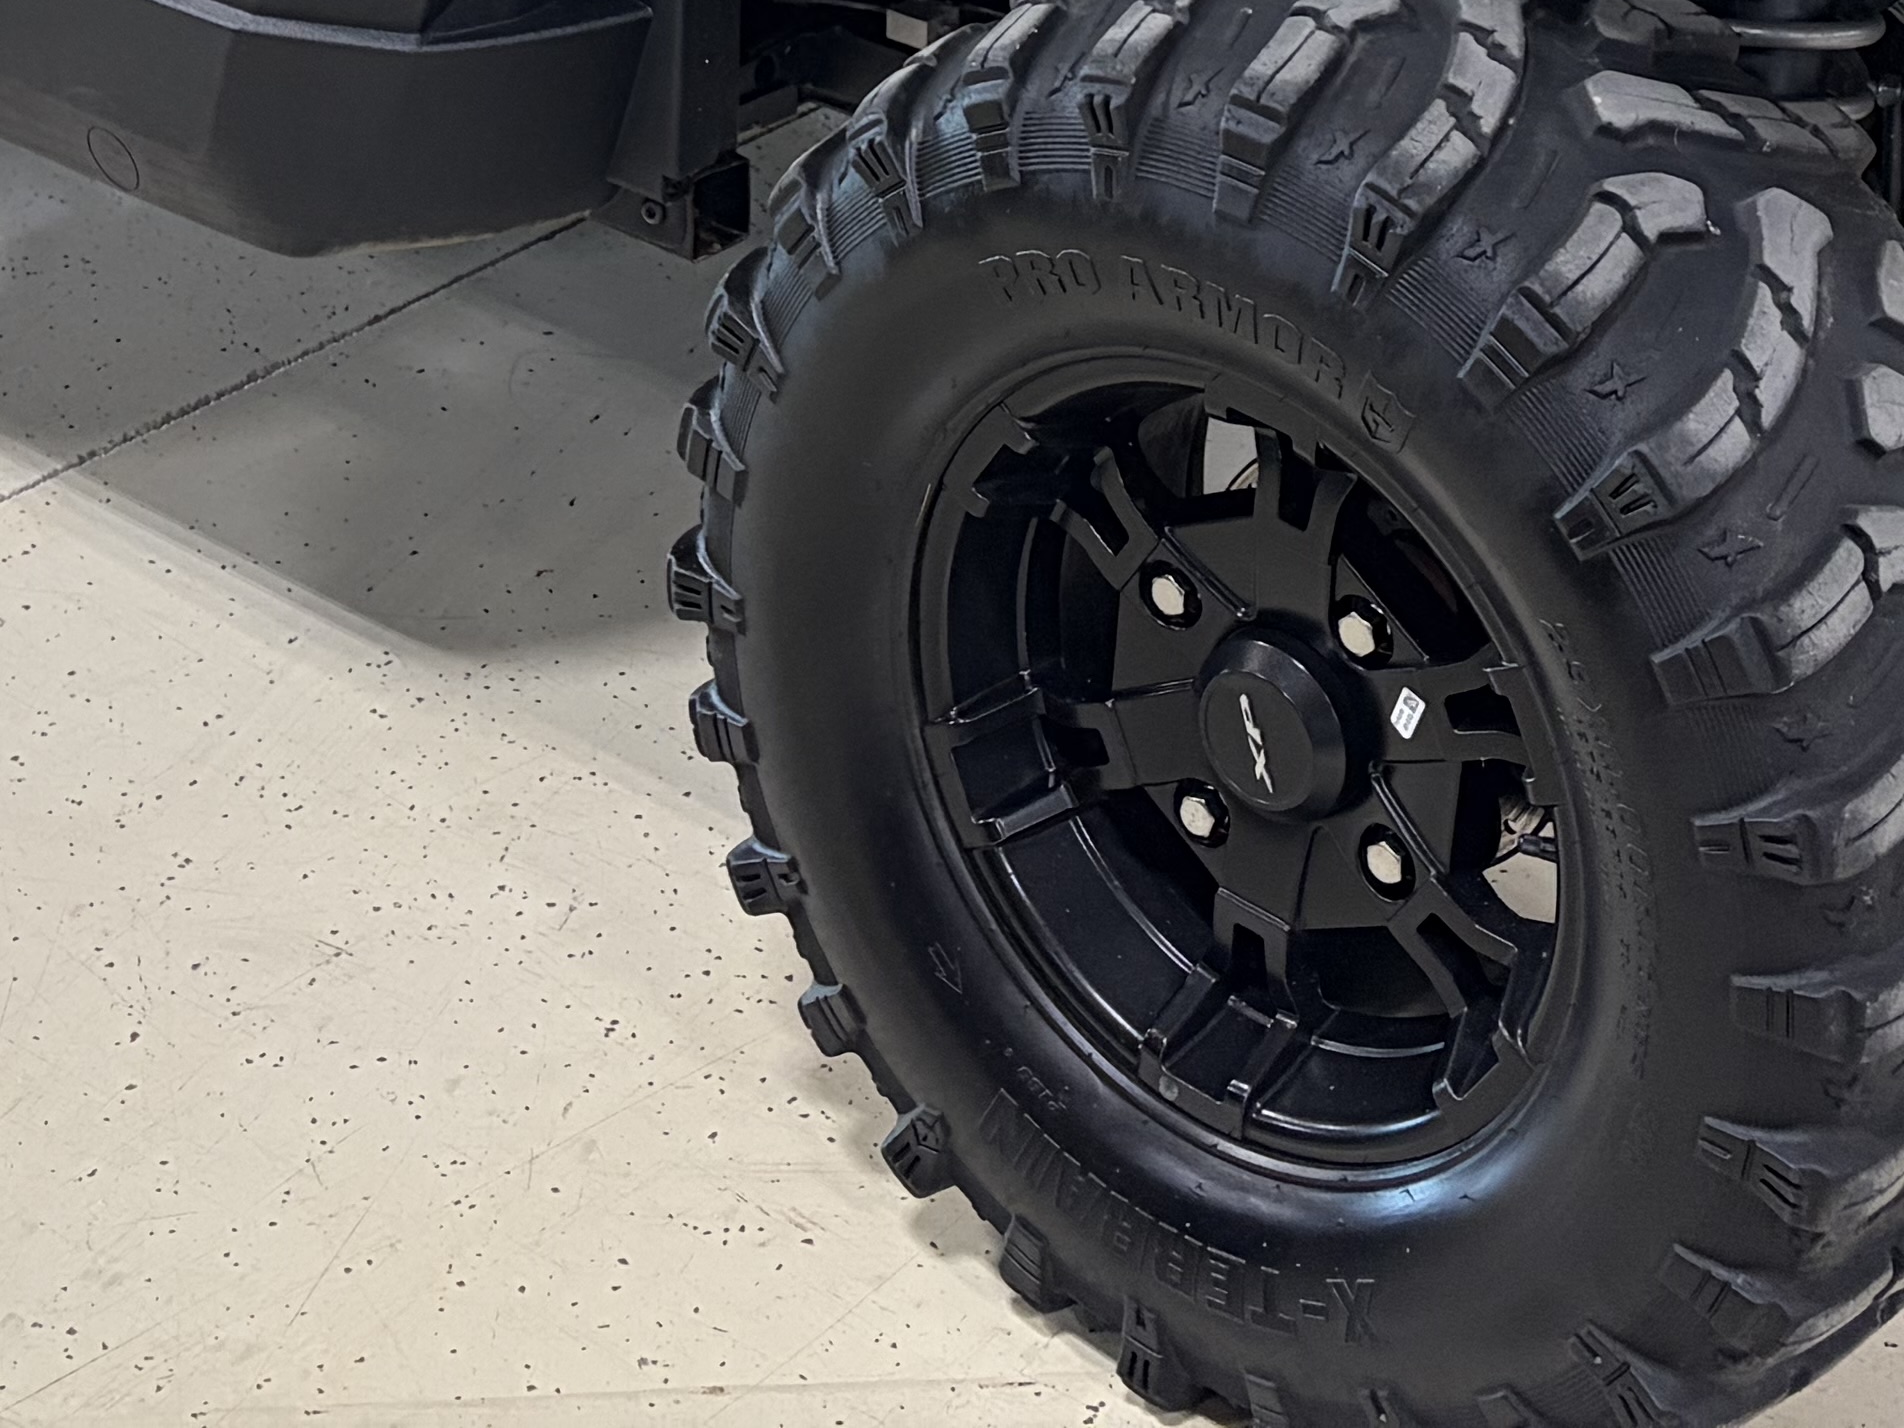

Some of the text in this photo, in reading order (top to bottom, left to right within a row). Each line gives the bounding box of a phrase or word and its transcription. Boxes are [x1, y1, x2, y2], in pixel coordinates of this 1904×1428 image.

[978, 248, 1349, 400] PRO ARMOR
[976, 1087, 1377, 1345] X-TERRAIN
